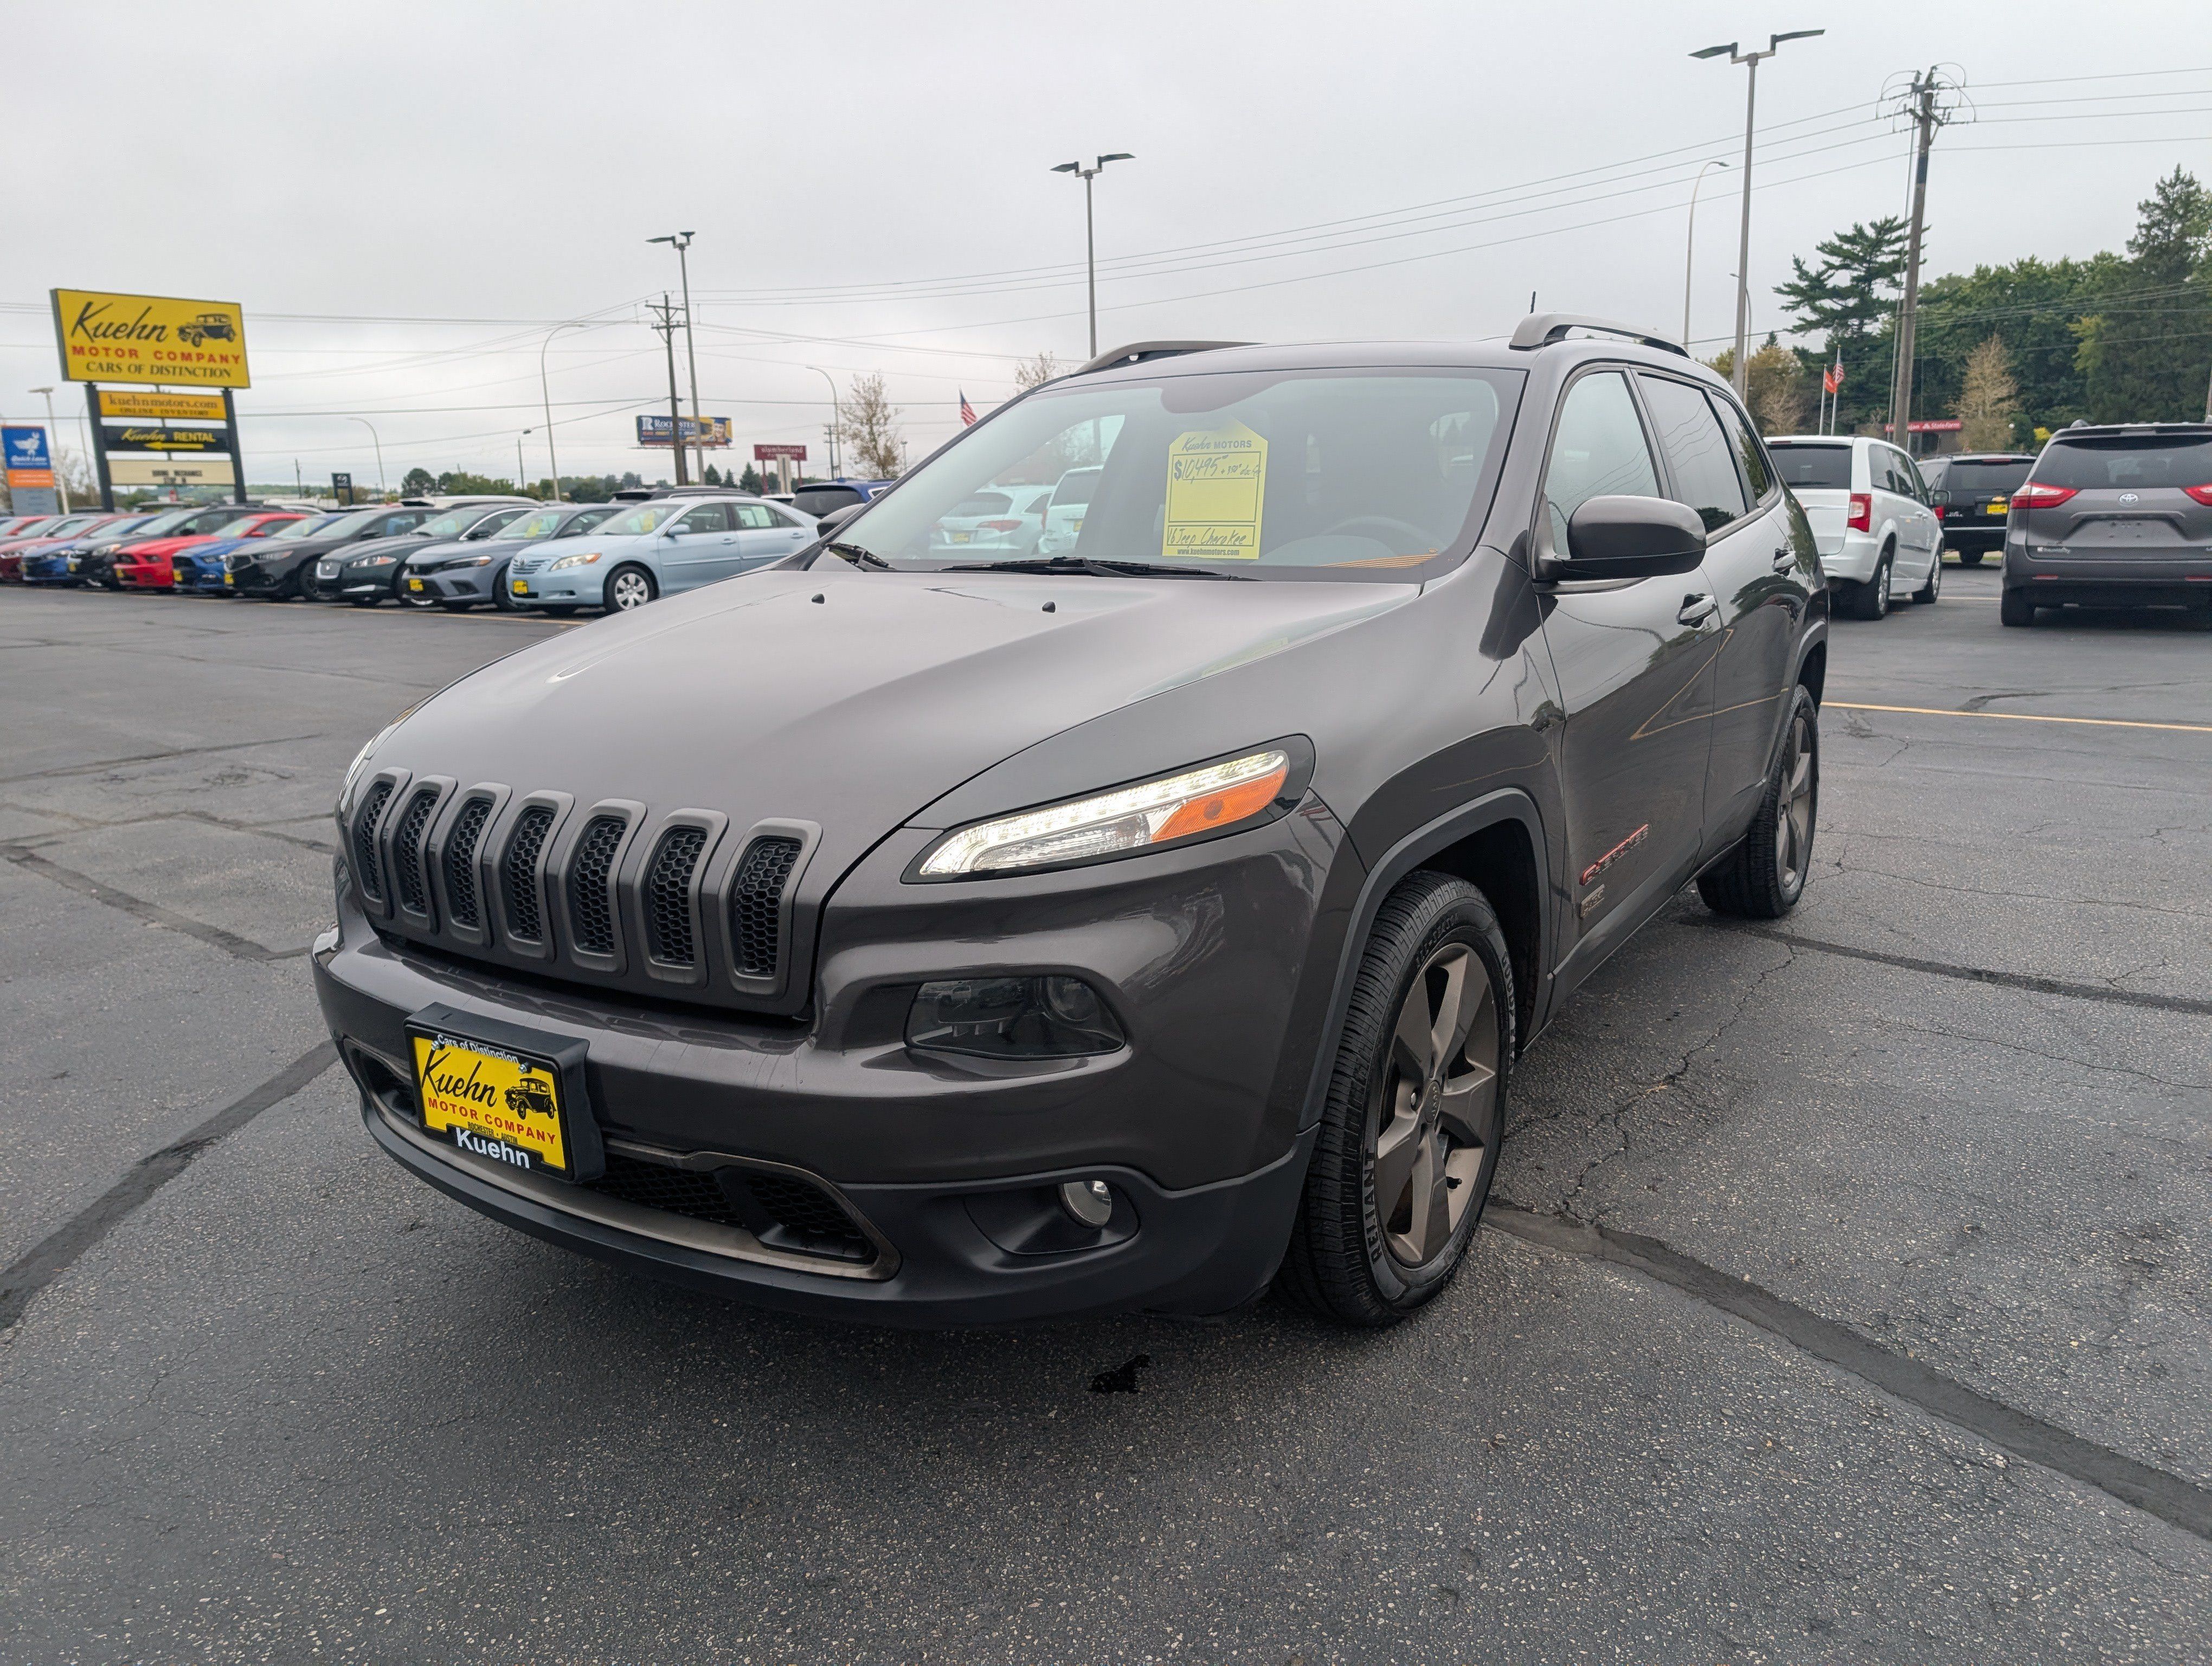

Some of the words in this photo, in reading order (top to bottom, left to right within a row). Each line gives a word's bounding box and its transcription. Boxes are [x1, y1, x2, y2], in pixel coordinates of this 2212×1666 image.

[71, 302, 168, 344] Kuehn
[72, 345, 139, 358] MOTOR
[154, 349, 240, 364] COMPANY
[86, 361, 123, 374] CARS
[128, 363, 145, 375] OF
[150, 364, 231, 378] DISTINCTION
[108, 395, 218, 409] kuehnmotors.com
[121, 428, 165, 442] Kuehn
[173, 431, 217, 443] RENTAL
[1182, 435, 1211, 452] Kuehn
[1213, 440, 1252, 450] MOTORS
[1176, 528, 1197, 548] Jeep
[437, 1034, 459, 1048] Cars
[459, 1041, 468, 1050] of
[469, 1042, 519, 1064] Distinction
[421, 1046, 497, 1108] Kuehn
[428, 1097, 478, 1120] MOTOR
[484, 1113, 556, 1145] COMPANY
[467, 1121, 494, 1138] ROCHESTER
[501, 1132, 518, 1144] AUSTIN
[455, 1126, 530, 1169] Kuehn
[1364, 1148, 1384, 1265] RELIANT
